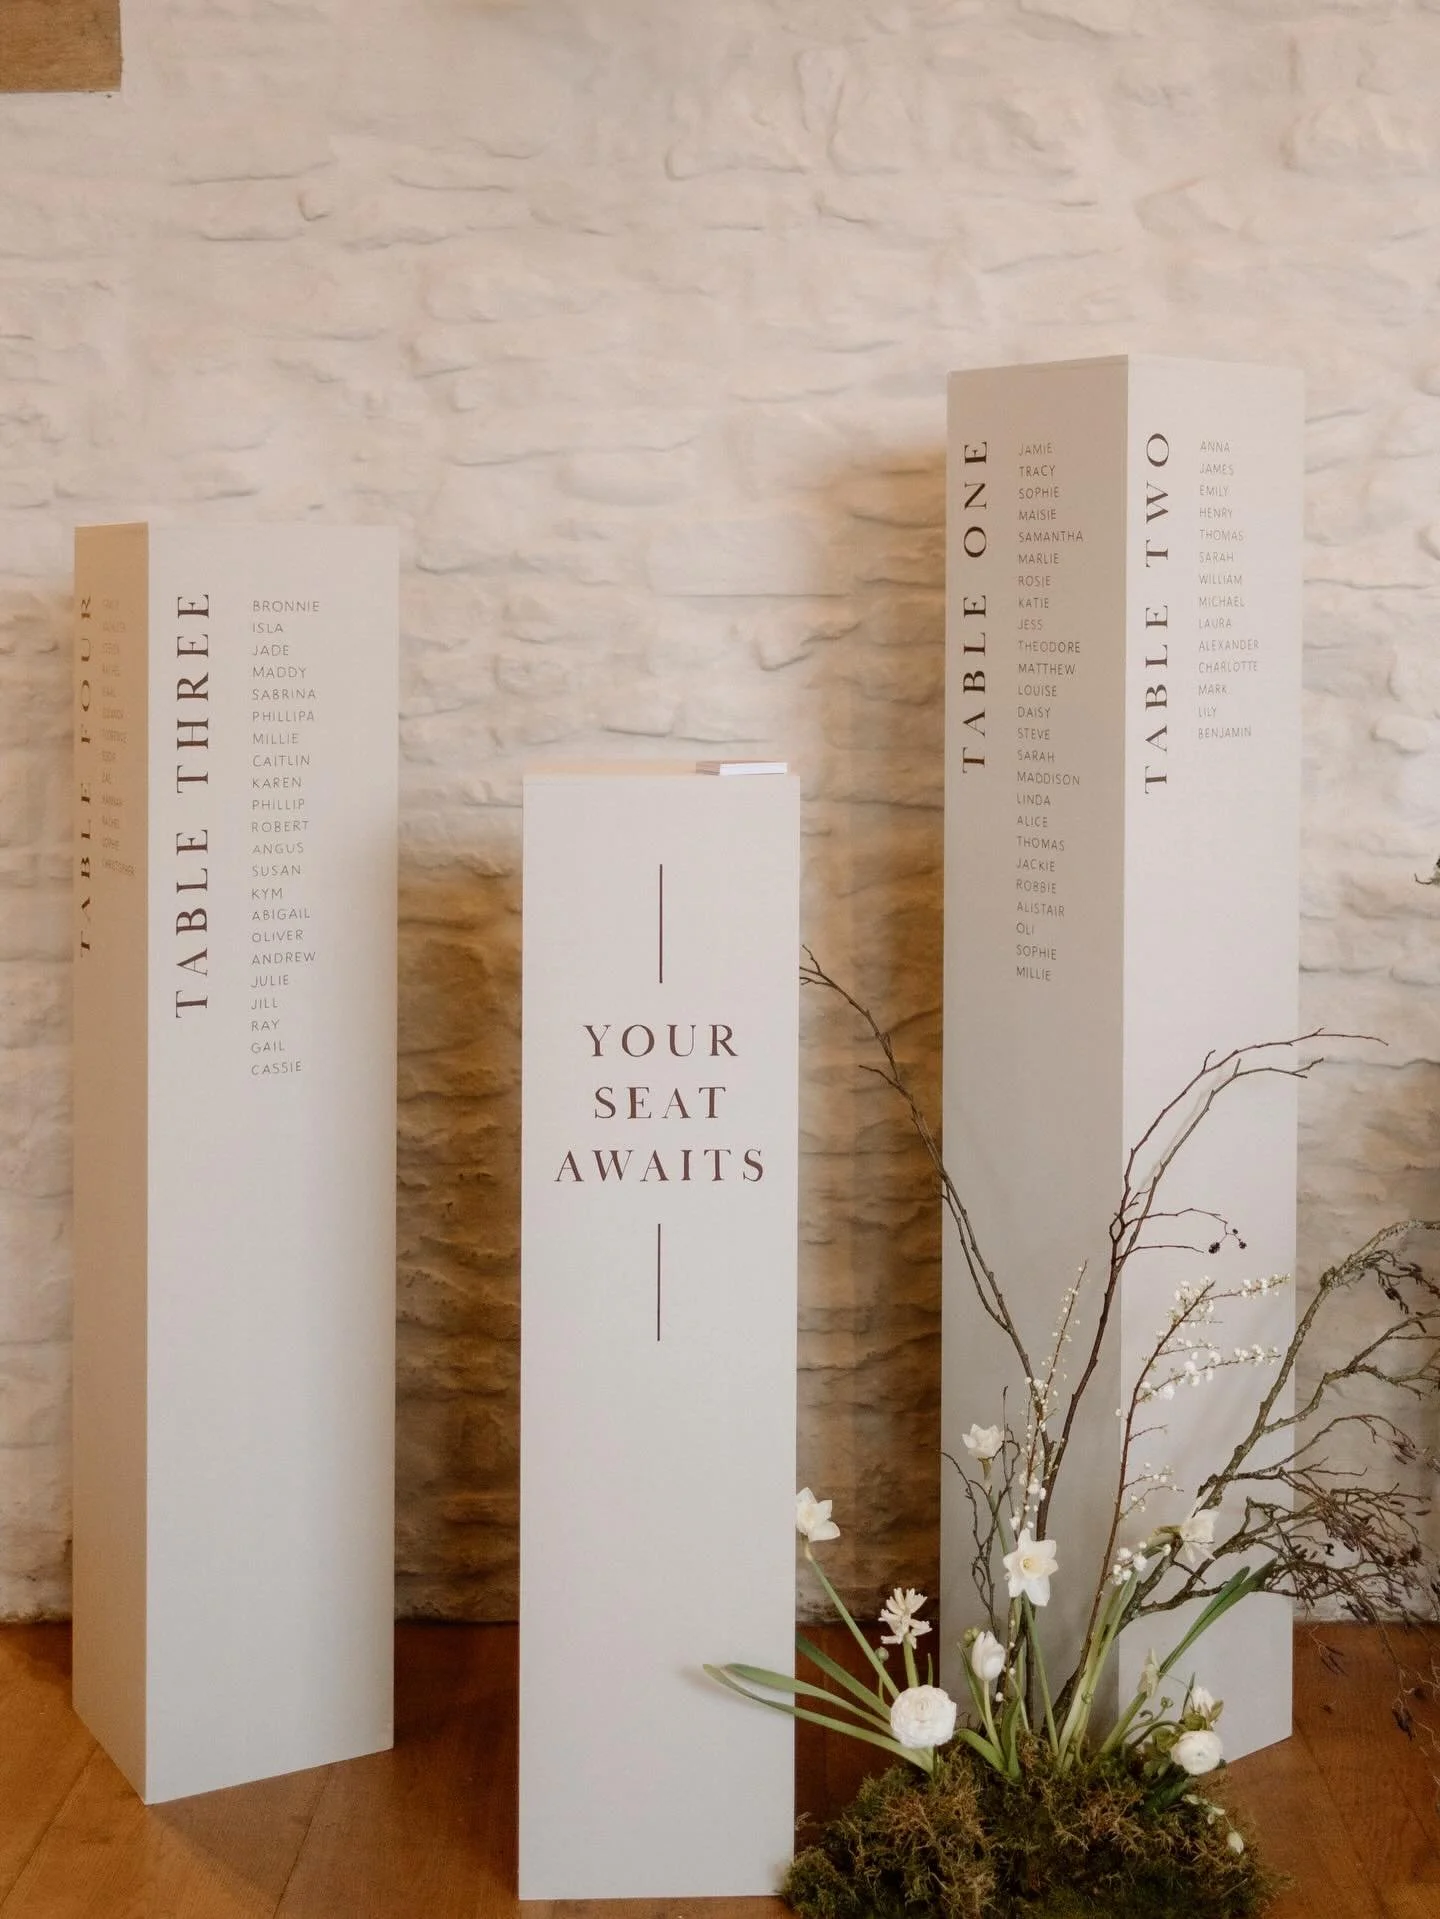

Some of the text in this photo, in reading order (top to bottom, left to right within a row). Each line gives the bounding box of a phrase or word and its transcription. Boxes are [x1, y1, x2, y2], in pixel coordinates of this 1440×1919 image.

[1017, 442, 1053, 456] JAMIE
[1199, 440, 1231, 453] ANNA
[1018, 464, 1057, 481] TRACY
[1199, 464, 1235, 476] JAMES
[1016, 483, 1061, 499] SOPHIE
[1199, 485, 1232, 497] EMILY
[1016, 509, 1057, 520] MAISIE
[1199, 507, 1233, 520] HENRY
[1015, 528, 1084, 544] SAMANTHA
[1199, 528, 1244, 541] THOMAS
[1016, 552, 1060, 565] MARLIE
[1199, 552, 1234, 564] SARAH
[1017, 576, 1052, 588] ROSIE
[1197, 574, 1243, 585] WILLIAM
[252, 600, 320, 613] BRONNIE
[962, 440, 988, 773] TABLE ONE
[1015, 597, 1049, 608] KATIE
[1198, 596, 1245, 608] MICHAEL
[1144, 432, 1170, 794] TABLE TWO
[252, 623, 284, 633] ISLA
[1017, 619, 1044, 632] JESS
[1198, 616, 1233, 629] LAURA
[251, 644, 289, 656] JADE
[1015, 640, 1081, 654] THEODORE
[1198, 639, 1260, 652] ALEXANDER
[1015, 663, 1077, 675] MATTHEW
[1198, 658, 1258, 673] CHARLOTTE
[252, 666, 307, 679] MADDY
[251, 688, 316, 700] SABRINA
[1017, 683, 1058, 697] LOUISE
[1197, 683, 1231, 696] MARK
[252, 710, 315, 722] PHILLIPA
[1015, 706, 1051, 719] DAISY
[1198, 704, 1217, 718] LILY
[252, 733, 299, 744] MILLIE
[1015, 727, 1051, 740] STEVE
[1197, 726, 1252, 740] BENJAMIN
[251, 754, 311, 768] CAITLIN
[1016, 750, 1057, 763] SARAH
[252, 776, 302, 789] KAREN
[1016, 770, 1081, 785] MADDISON
[176, 593, 210, 1018] TABLE THREE
[251, 798, 305, 810] PHILLIP
[1016, 792, 1052, 808] LINDA
[251, 820, 310, 832] ROBERT
[1016, 816, 1049, 828] ALICE
[251, 842, 304, 854] ANGUS
[1016, 835, 1065, 852] THOMAS
[251, 864, 301, 877] SUSAN
[1015, 858, 1057, 872] JACKIE
[1015, 878, 1057, 894] ROBBIE
[250, 888, 284, 900] KYM
[251, 907, 312, 921] ABIGAIL
[1015, 901, 1065, 917] ALISTAIR
[1015, 920, 1035, 935] OLI
[250, 929, 305, 943] OLIVER
[250, 952, 316, 965] ANDREW
[1015, 944, 1057, 960] SOPHIE
[1015, 966, 1052, 982] MILLIE
[250, 975, 289, 988] JULIE
[250, 998, 279, 1010] JILL
[250, 1019, 280, 1032] RAY
[249, 1040, 285, 1054] GAIL
[583, 1024, 739, 1057] YOUR
[250, 1060, 302, 1075] CASSIE
[594, 1086, 727, 1120] SEAT
[553, 1148, 764, 1182] AWAITS
